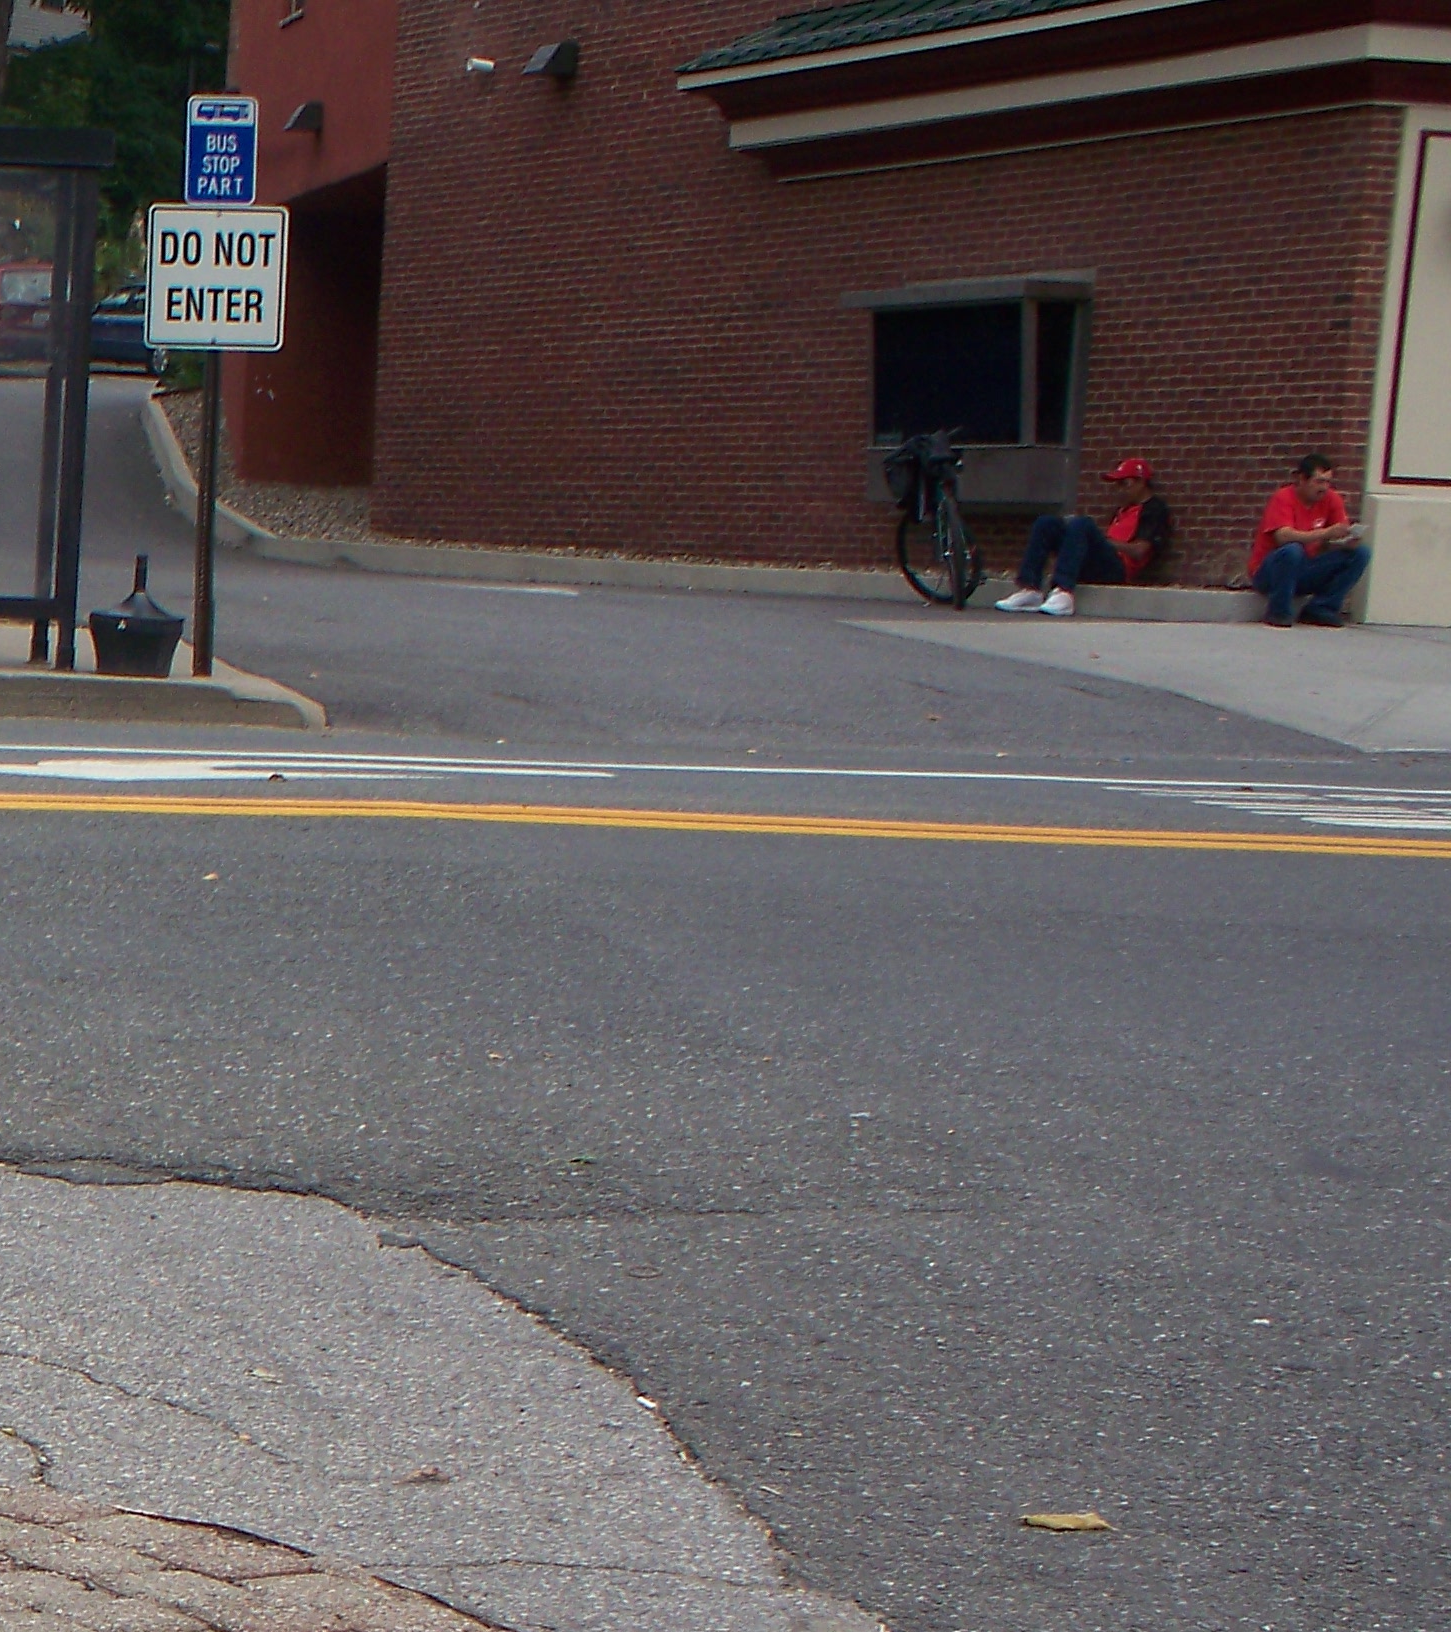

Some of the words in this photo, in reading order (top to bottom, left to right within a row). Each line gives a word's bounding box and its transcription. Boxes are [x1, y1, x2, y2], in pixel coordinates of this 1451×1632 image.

[206, 132, 238, 154] BUS
[201, 154, 242, 175] STOP
[160, 230, 201, 267] DO
[213, 230, 276, 268] NOT
[166, 286, 263, 324] ENTER
